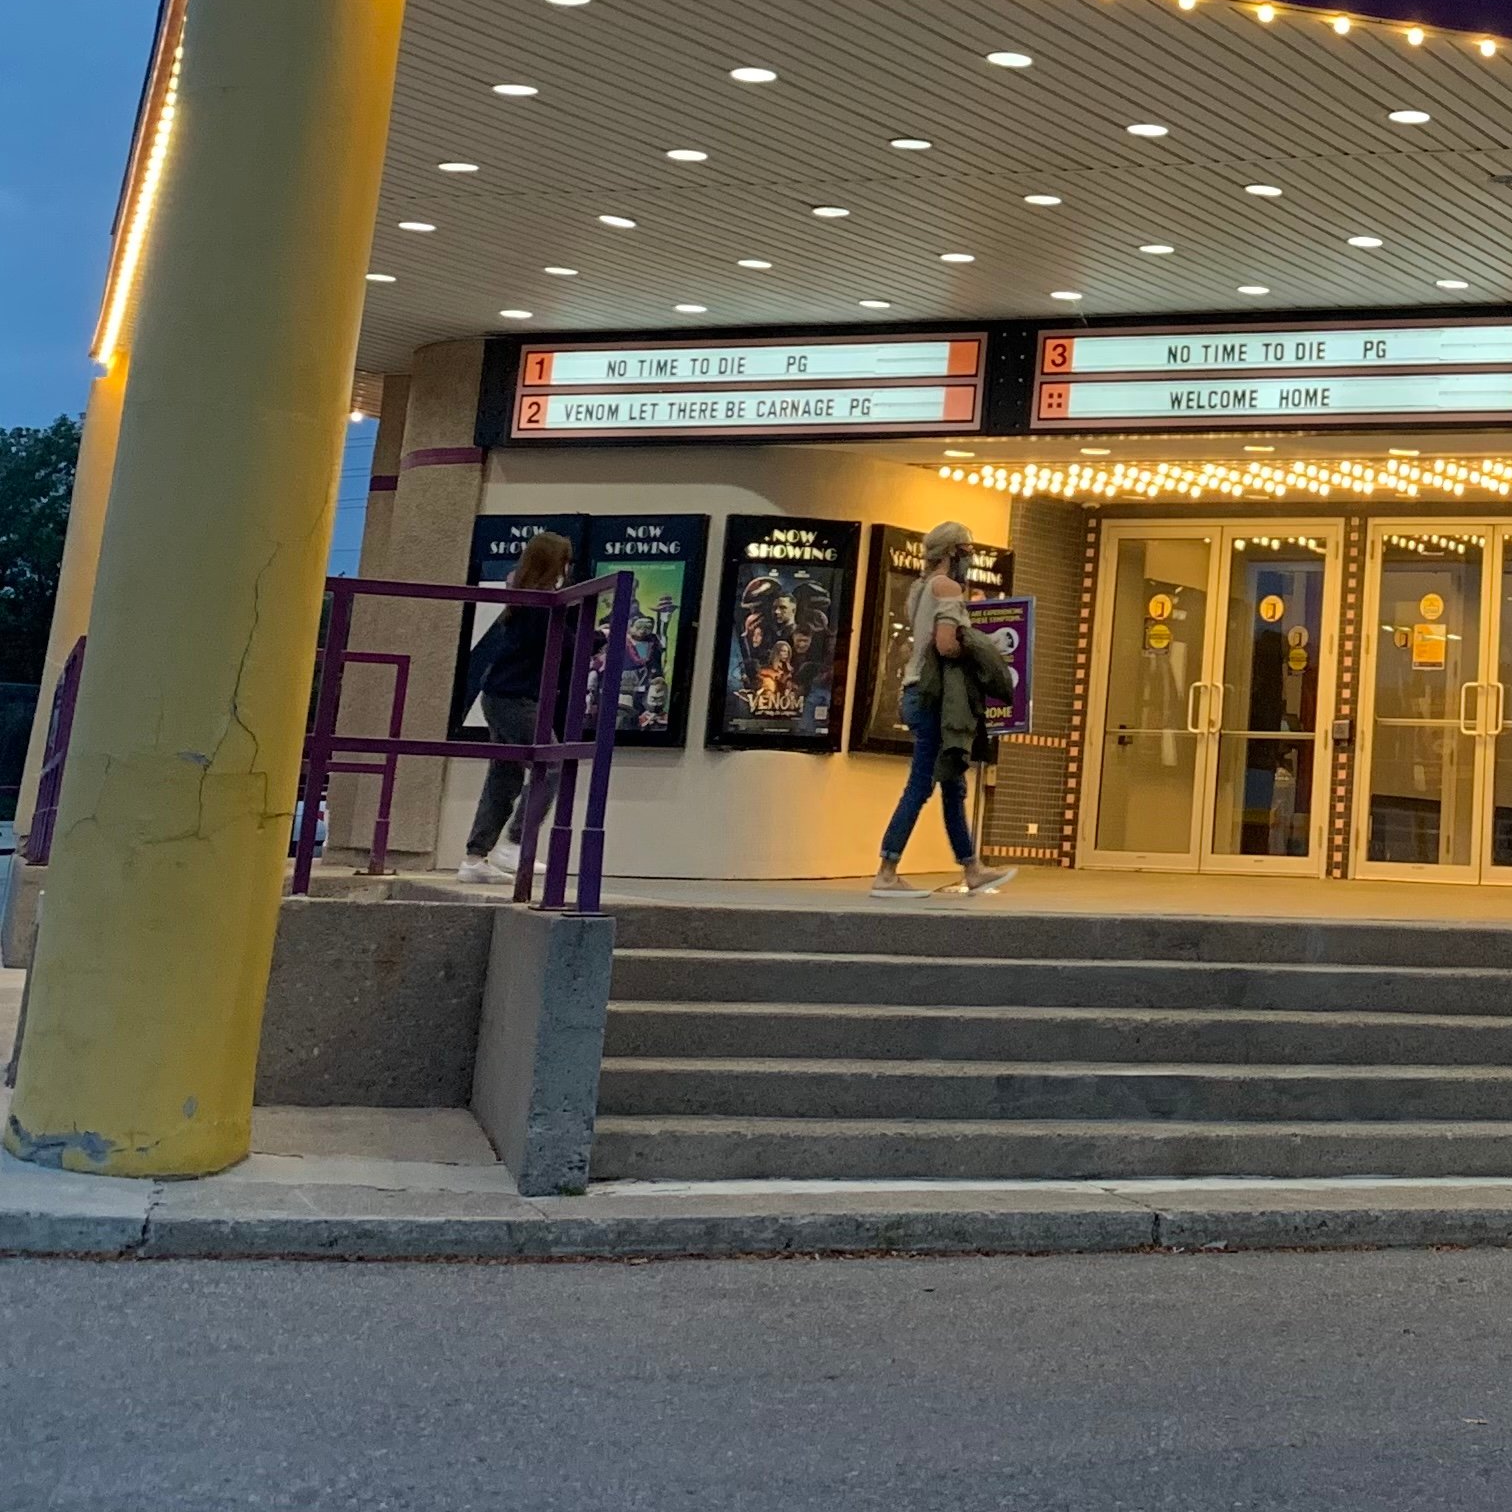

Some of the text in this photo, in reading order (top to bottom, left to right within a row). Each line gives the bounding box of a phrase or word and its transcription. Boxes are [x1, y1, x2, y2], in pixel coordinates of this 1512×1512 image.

[1050, 343, 1067, 367] 3
[1168, 340, 1387, 364] NO TIME TO DIE PG
[535, 358, 545, 380] 1
[606, 355, 808, 377] NO TIME TO DIE PG
[565, 397, 872, 422] VENOM LET THERE BE CARNAGE PG
[1170, 387, 1331, 410] WELCOME HOME
[526, 401, 541, 425] 2
[511, 525, 547, 538] NOW
[626, 525, 665, 538] NOW
[773, 528, 818, 545] NOW
[604, 541, 681, 555] SHOWING
[746, 543, 838, 562] SHOWING
[747, 688, 804, 713] VENOM
